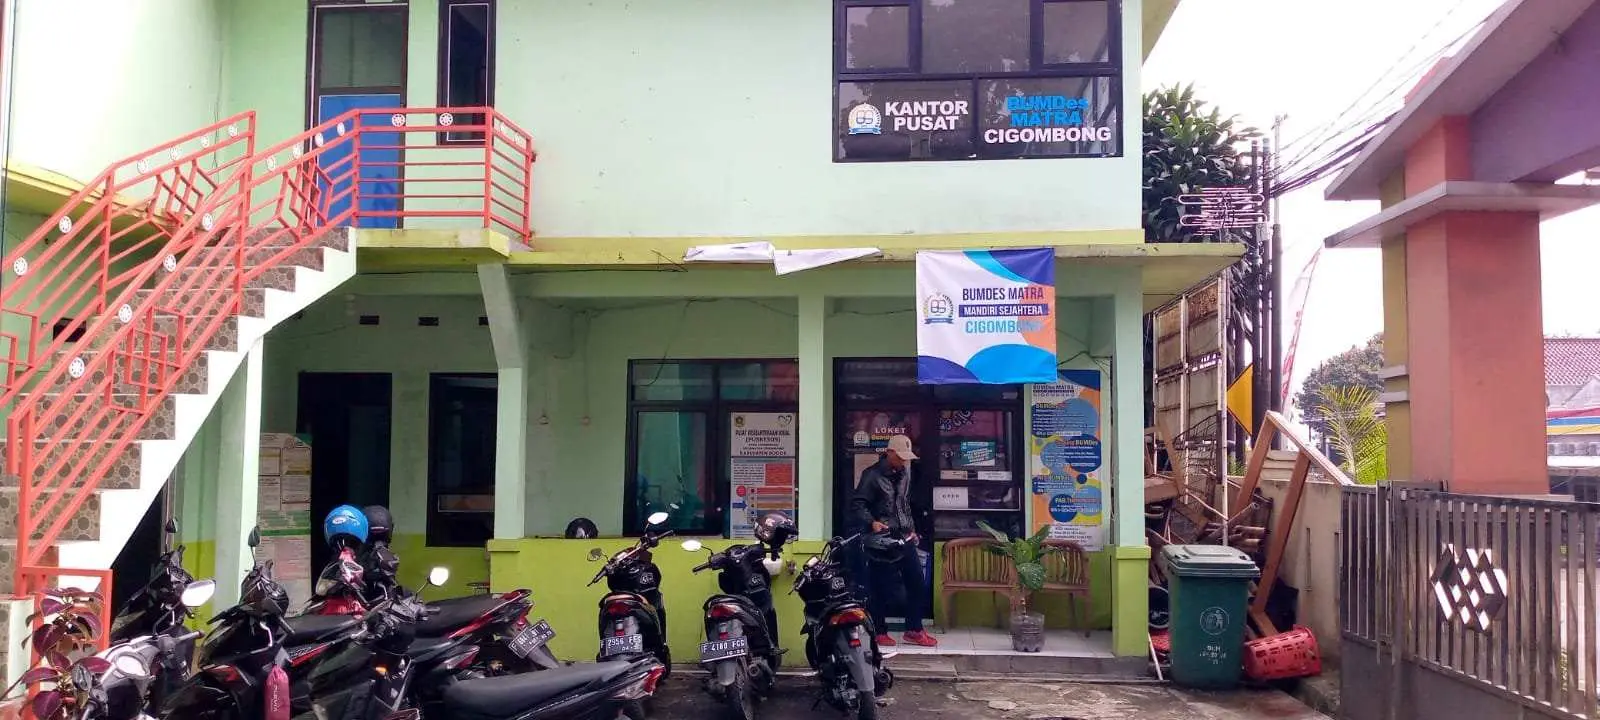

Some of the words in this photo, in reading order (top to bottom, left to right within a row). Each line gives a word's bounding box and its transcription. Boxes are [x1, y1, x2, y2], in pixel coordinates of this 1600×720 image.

[885, 100, 969, 117] KANTOR
[1007, 96, 1089, 111] BUMDes
[894, 115, 960, 131] PUSAT
[1010, 110, 1082, 127] MATRA
[984, 127, 1112, 144] CIGOMBONG
[962, 287, 1005, 301] BUMDES
[1008, 287, 1044, 300] MATRA
[963, 306, 998, 316] MANDIRI
[999, 305, 1043, 316] SEJAHTERA
